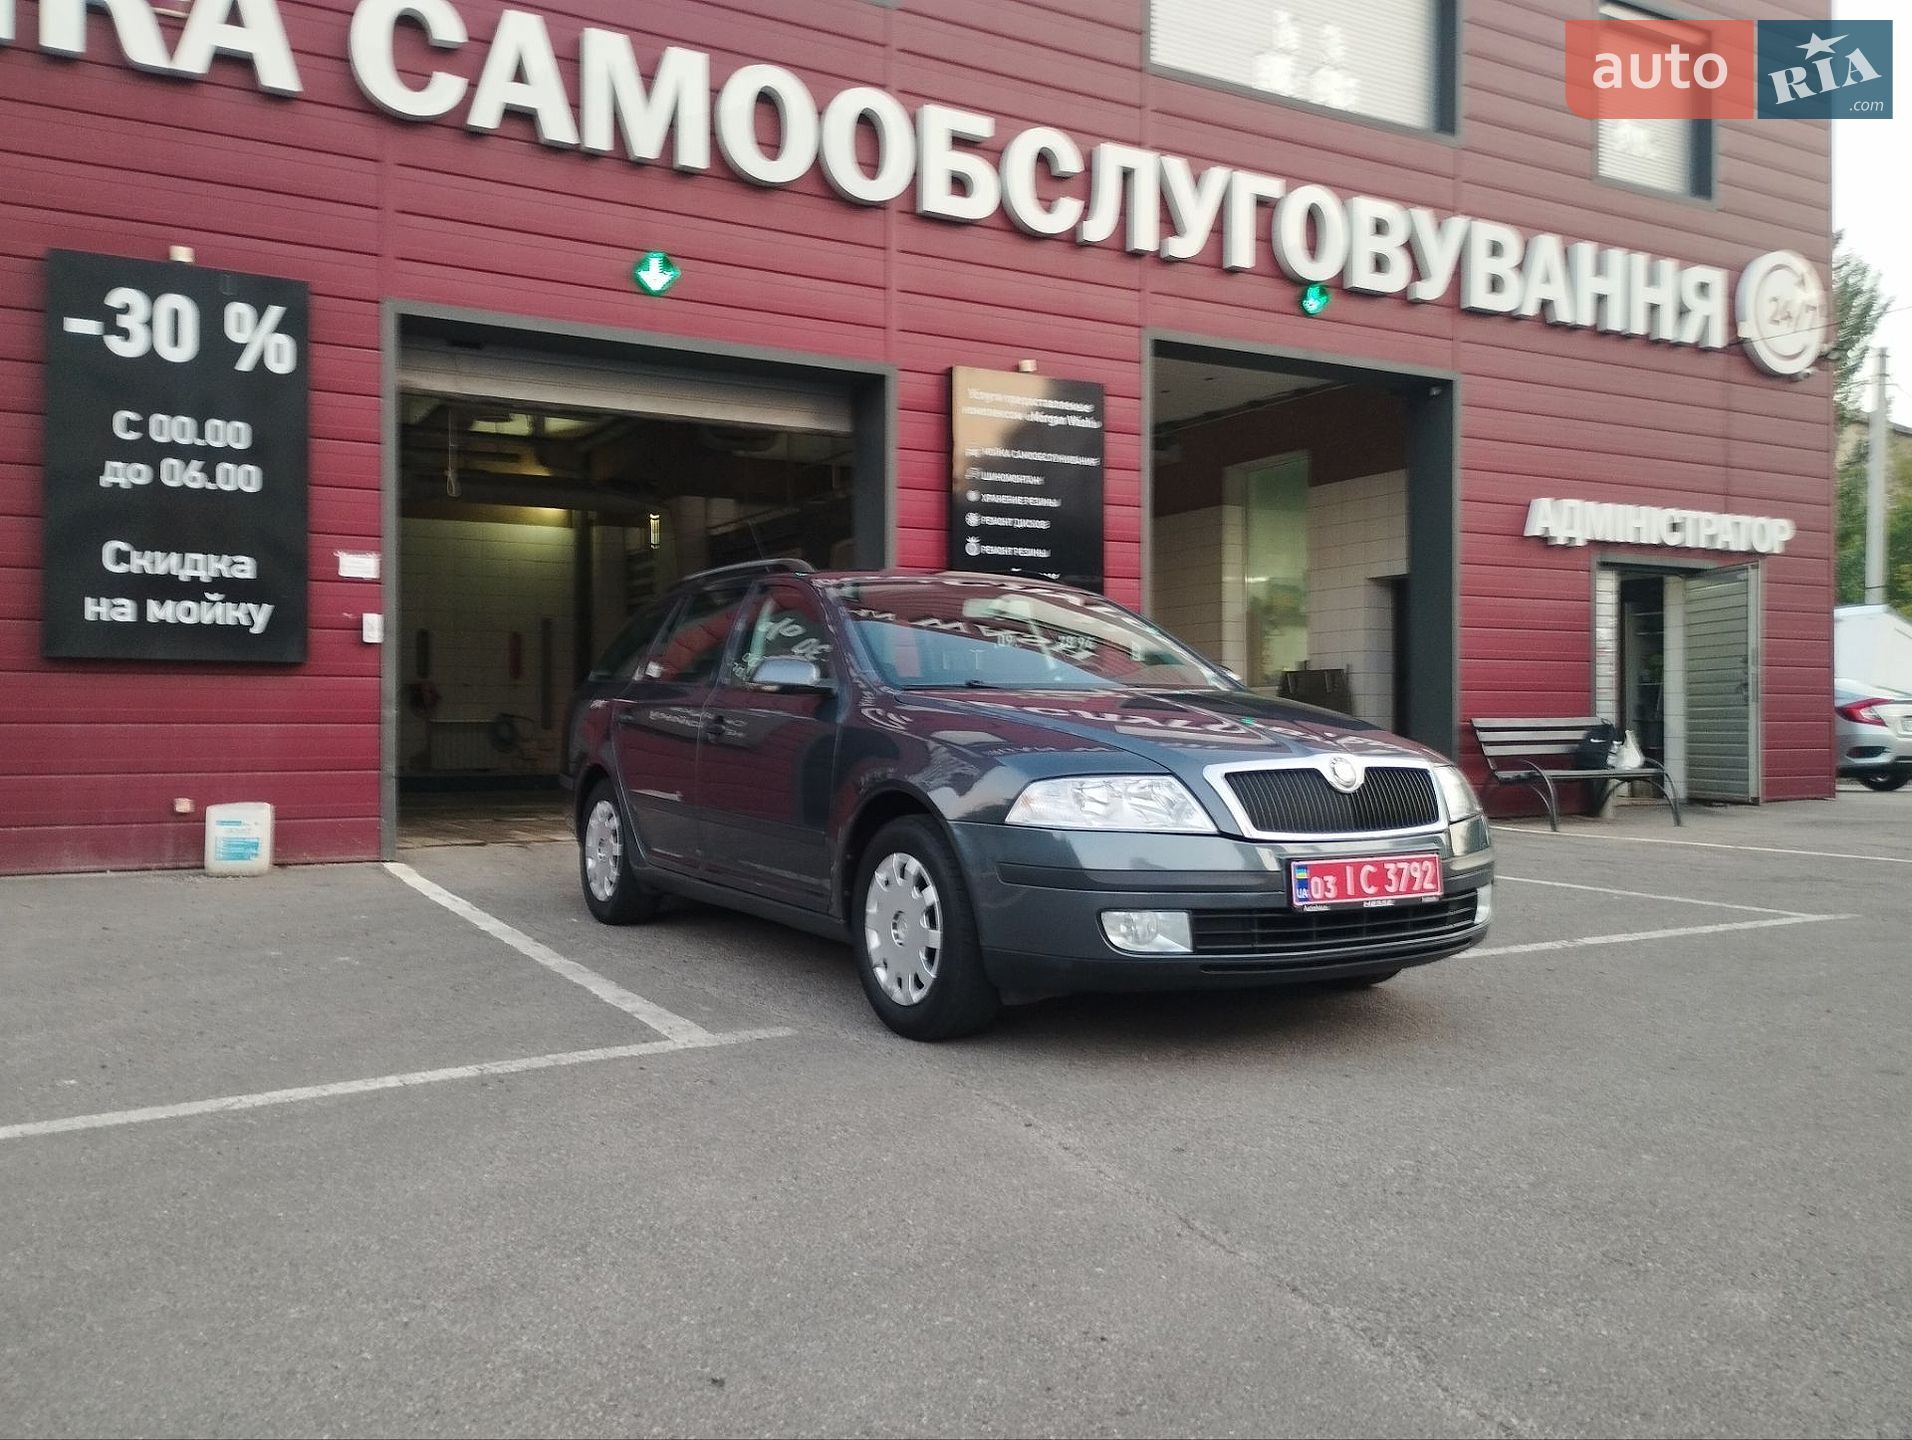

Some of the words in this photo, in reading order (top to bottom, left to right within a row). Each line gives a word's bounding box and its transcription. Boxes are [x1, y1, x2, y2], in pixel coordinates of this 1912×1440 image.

[348, 0, 1729, 349] САМООБСЛУГОВУВАННЯ
[223, 301, 298, 375] %
[148, 412, 254, 450] 00.00
[99, 459, 154, 489] до
[159, 457, 264, 493] 06.00
[1523, 497, 1796, 554] АДМІНІСТРАТОР
[101, 539, 259, 583] Скидка
[84, 594, 138, 623] на
[146, 591, 275, 635] мойку
[1310, 876, 1338, 899] 03
[1383, 860, 1437, 893] 3792
